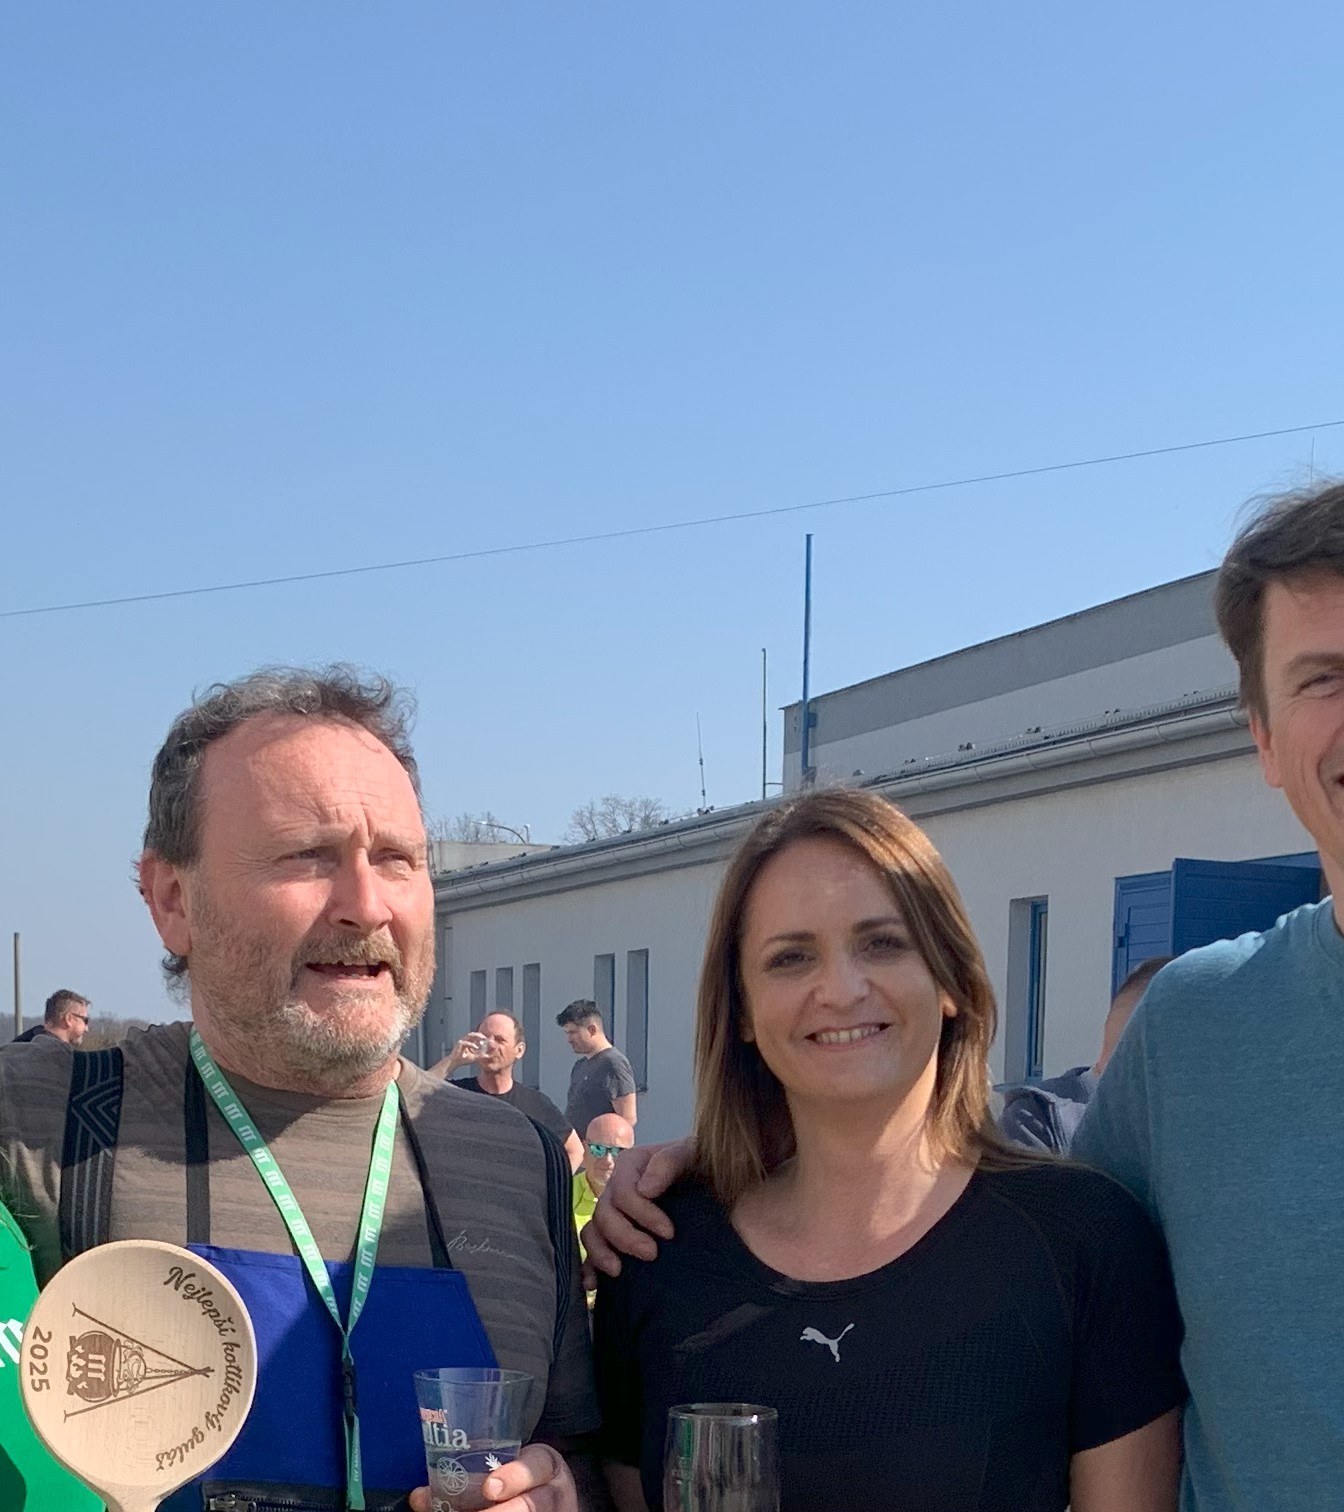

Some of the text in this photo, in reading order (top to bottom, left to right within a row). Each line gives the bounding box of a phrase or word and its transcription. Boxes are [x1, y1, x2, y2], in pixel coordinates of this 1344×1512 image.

[29, 1325, 53, 1393] 2025
[155, 1265, 243, 1472] Nejlepší kotlíkový guláš
